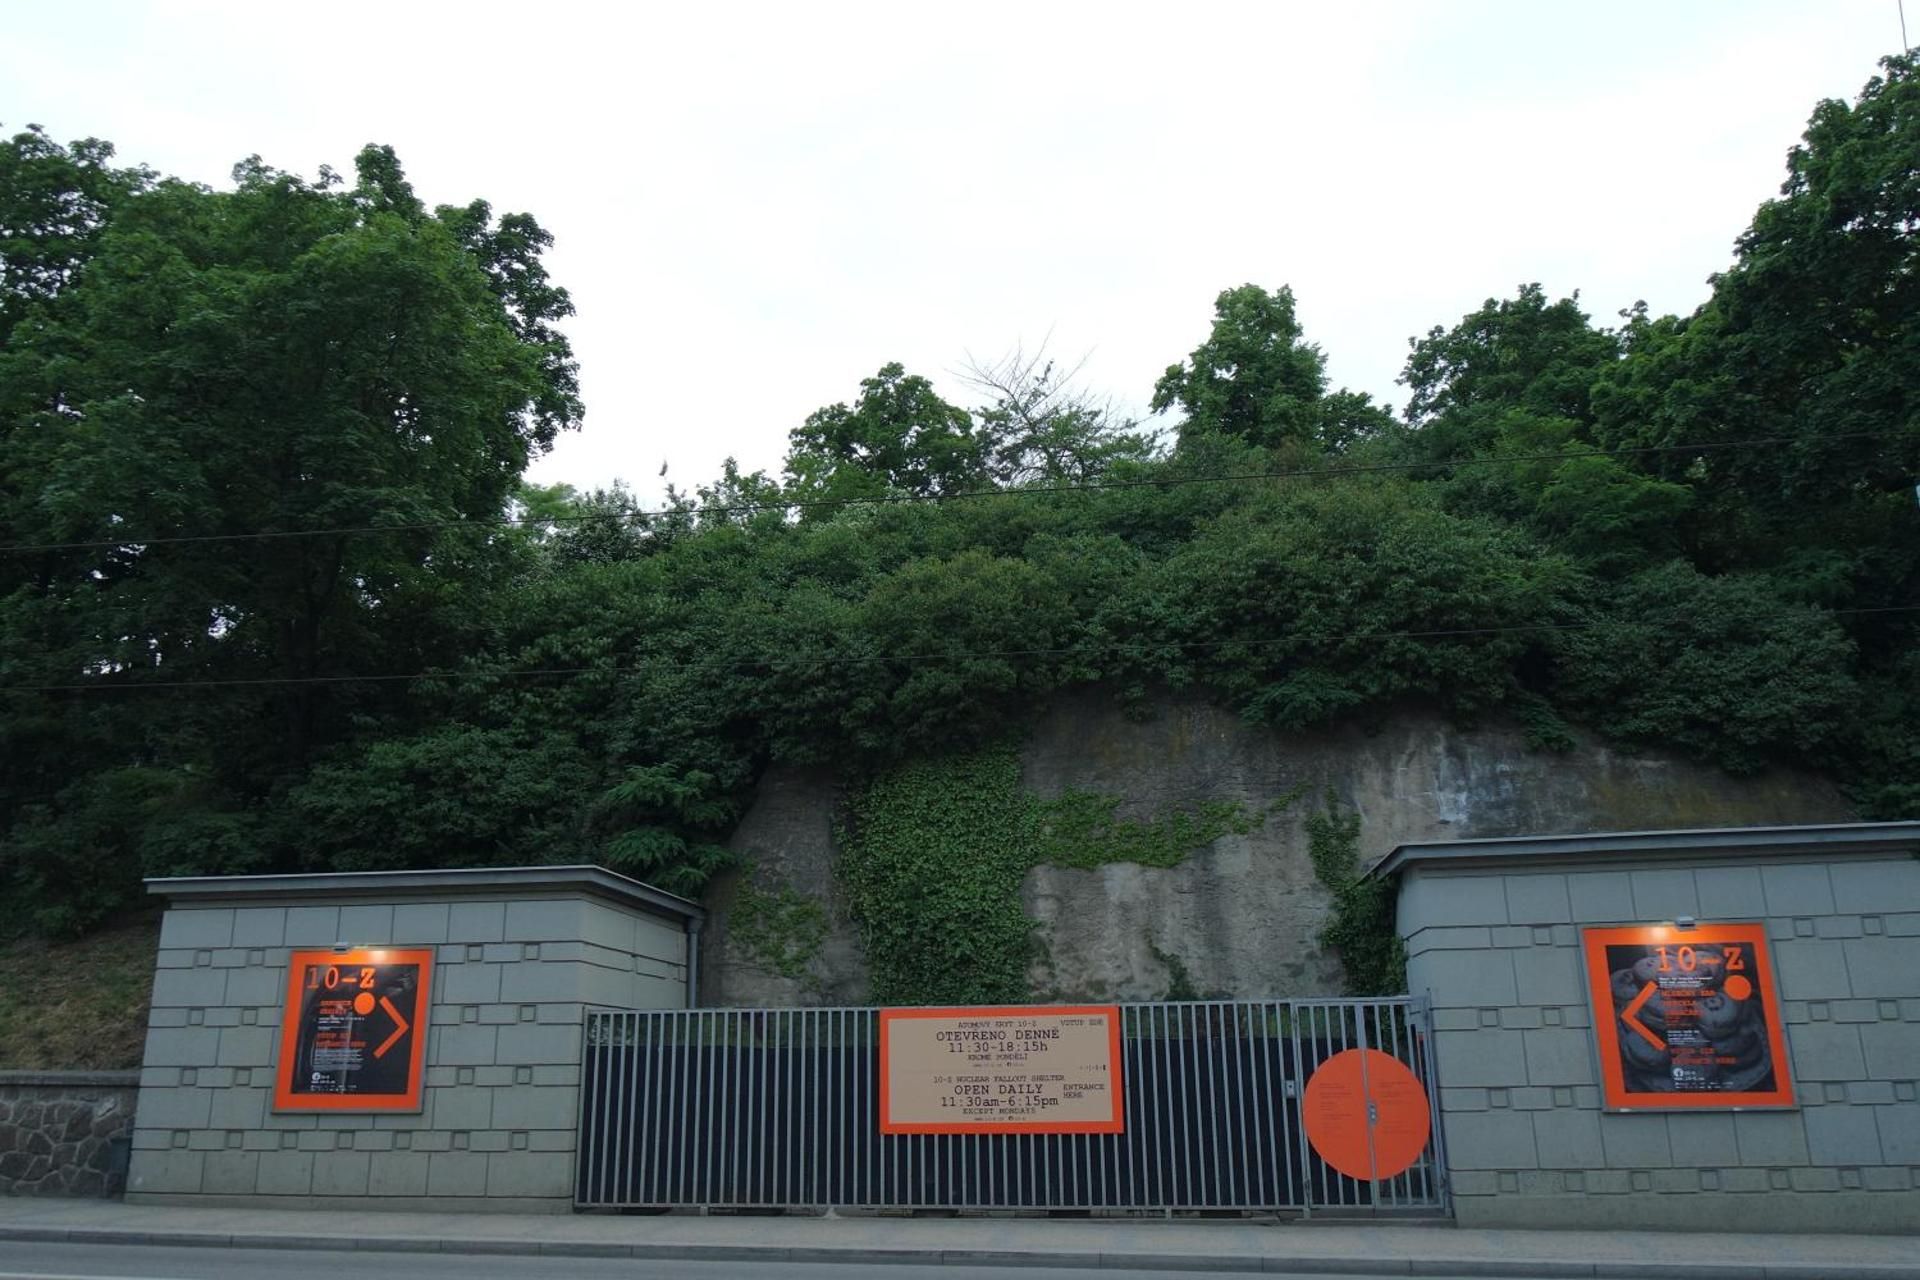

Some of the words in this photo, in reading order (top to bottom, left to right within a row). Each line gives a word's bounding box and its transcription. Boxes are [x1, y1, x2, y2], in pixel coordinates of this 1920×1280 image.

[1656, 946, 1744, 972] 10-Z
[306, 967, 376, 989] 10-Z
[949, 1041, 1048, 1052] 11:30-18:15h
[1031, 1074, 1064, 1082] SHELTER
[954, 1084, 990, 1095] OPEN
[999, 1084, 1044, 1094] DAILY
[941, 1096, 1059, 1108] 11:30am-6:15pm
